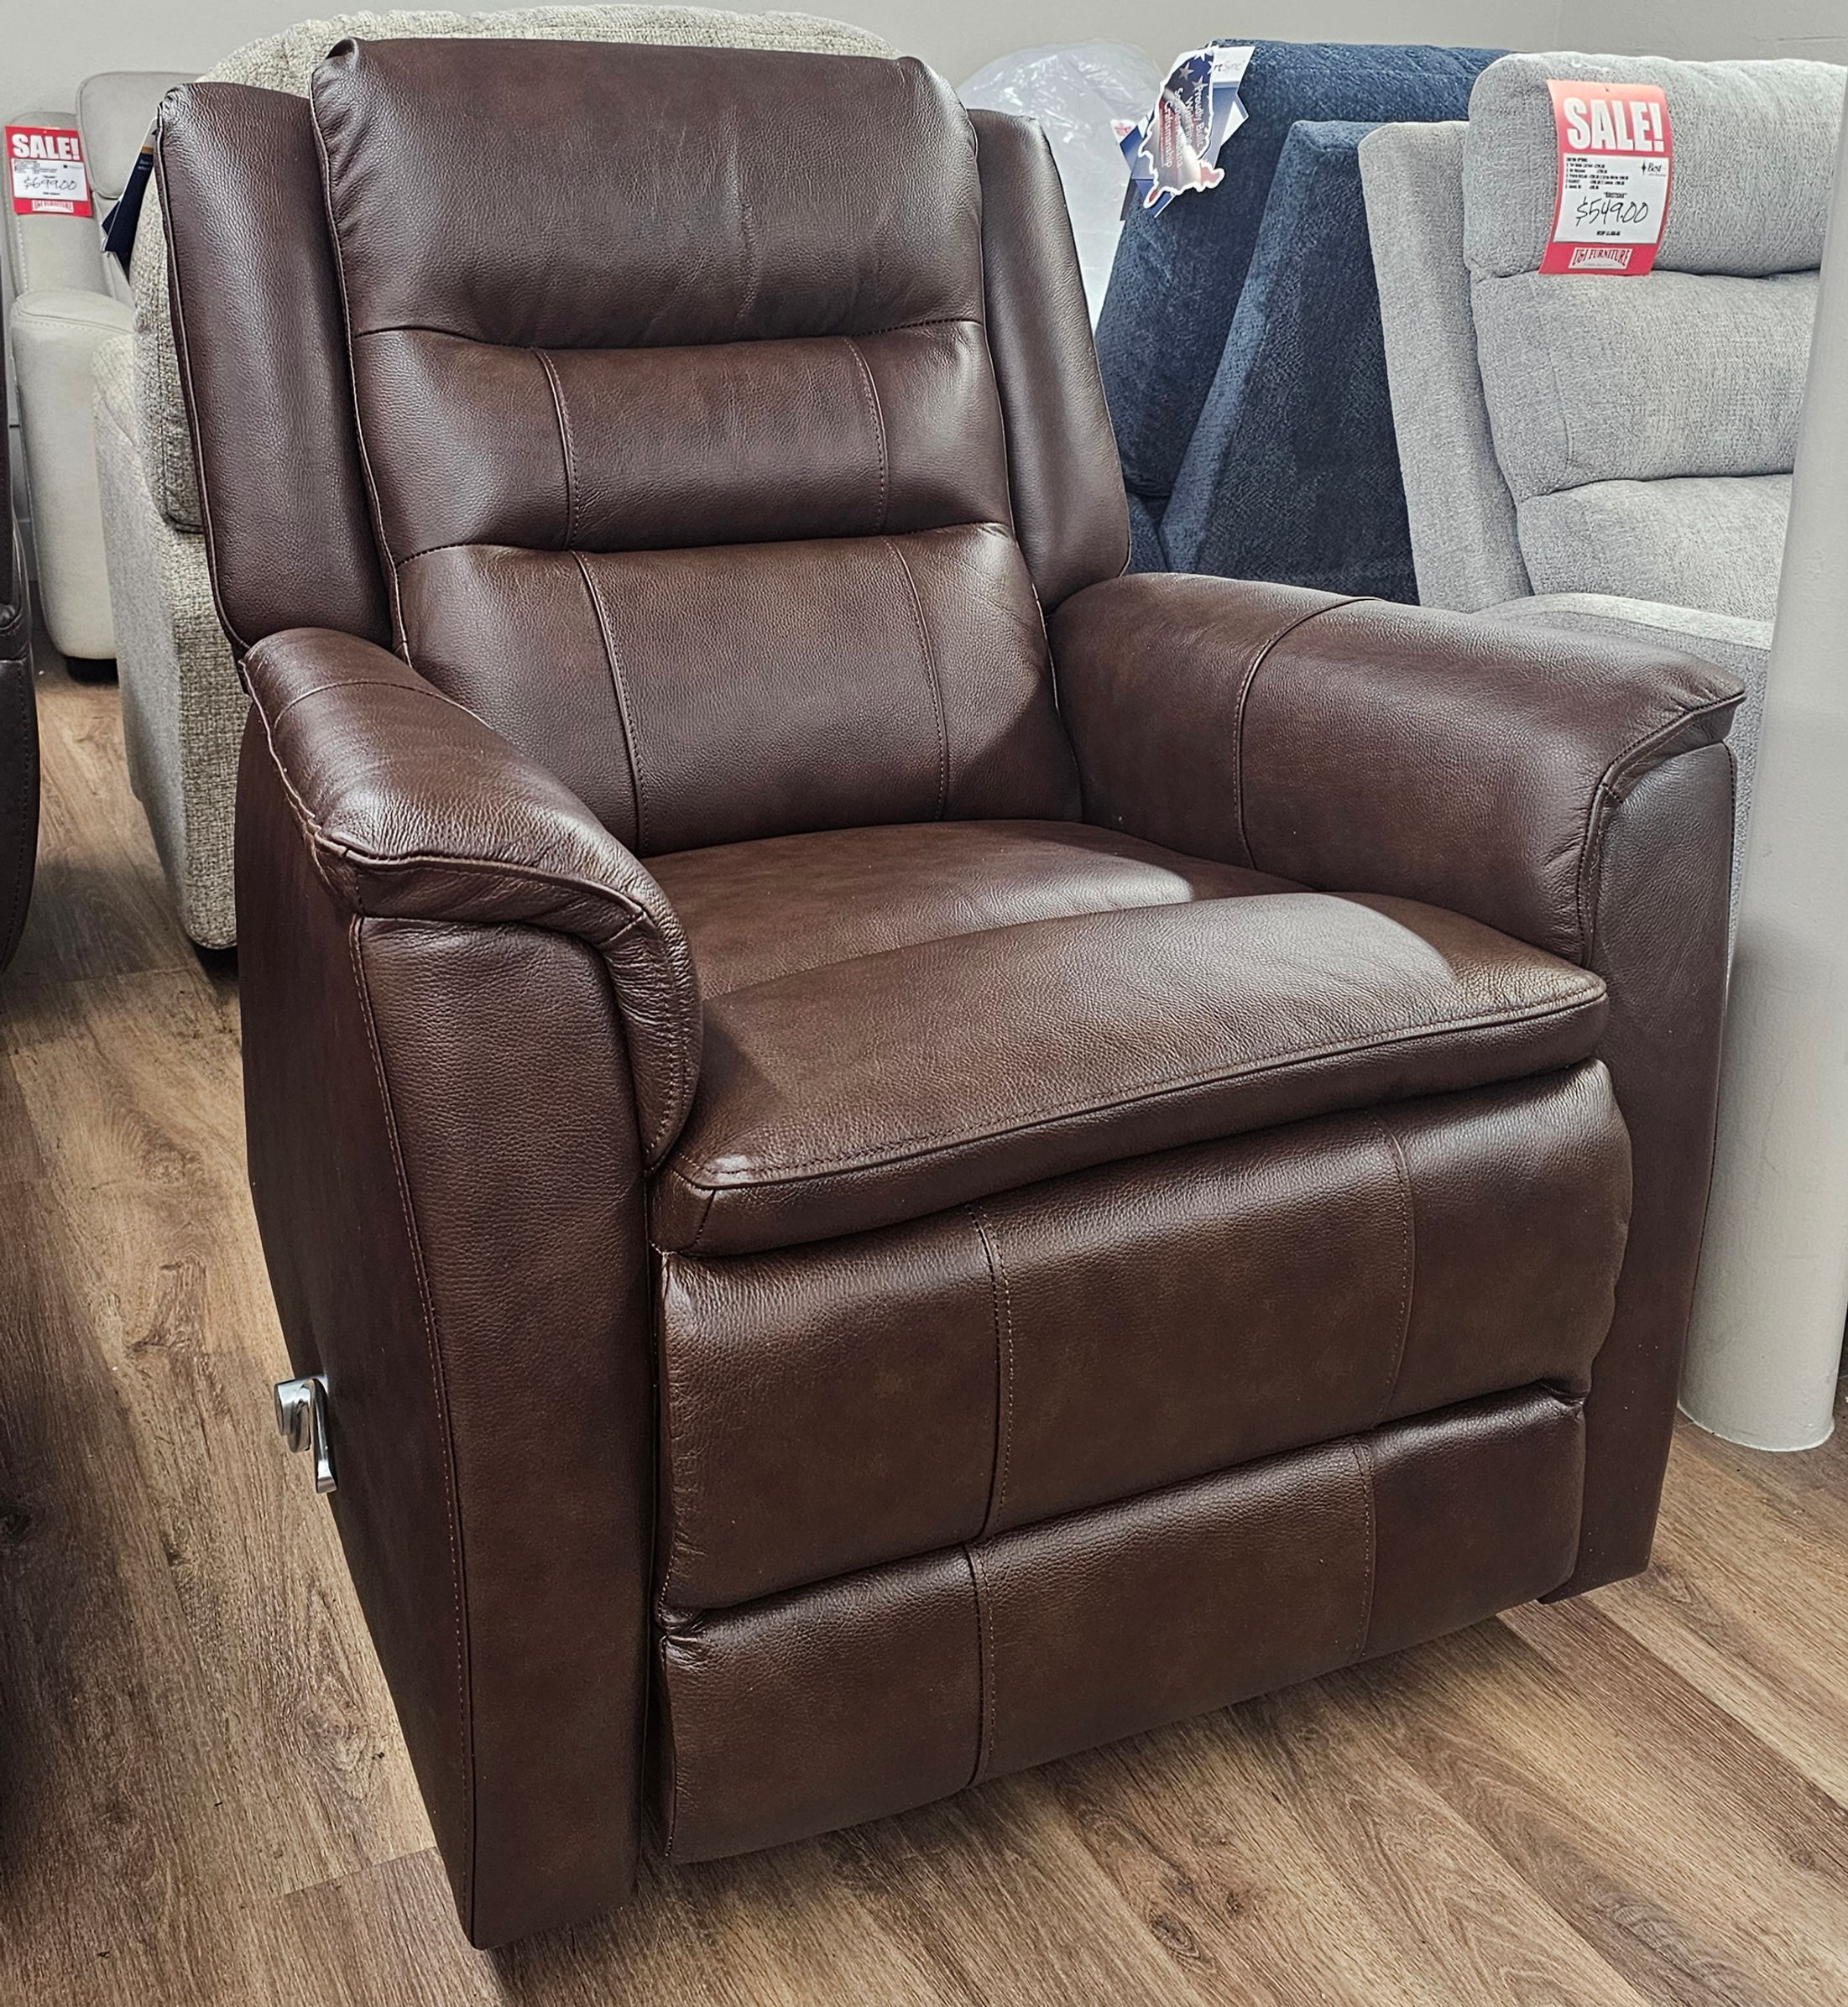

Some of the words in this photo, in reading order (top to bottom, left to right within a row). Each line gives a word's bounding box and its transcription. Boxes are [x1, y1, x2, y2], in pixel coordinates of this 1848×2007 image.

[1193, 86, 1205, 121] Proudly
[1164, 101, 1174, 168] Craftsmanship
[1196, 122, 1205, 148] Built
[1563, 96, 1664, 153] SALE!
[12, 133, 81, 161] SALE!
[1575, 195, 1649, 227] $549.00
[1589, 249, 1630, 266] FURNITURE
